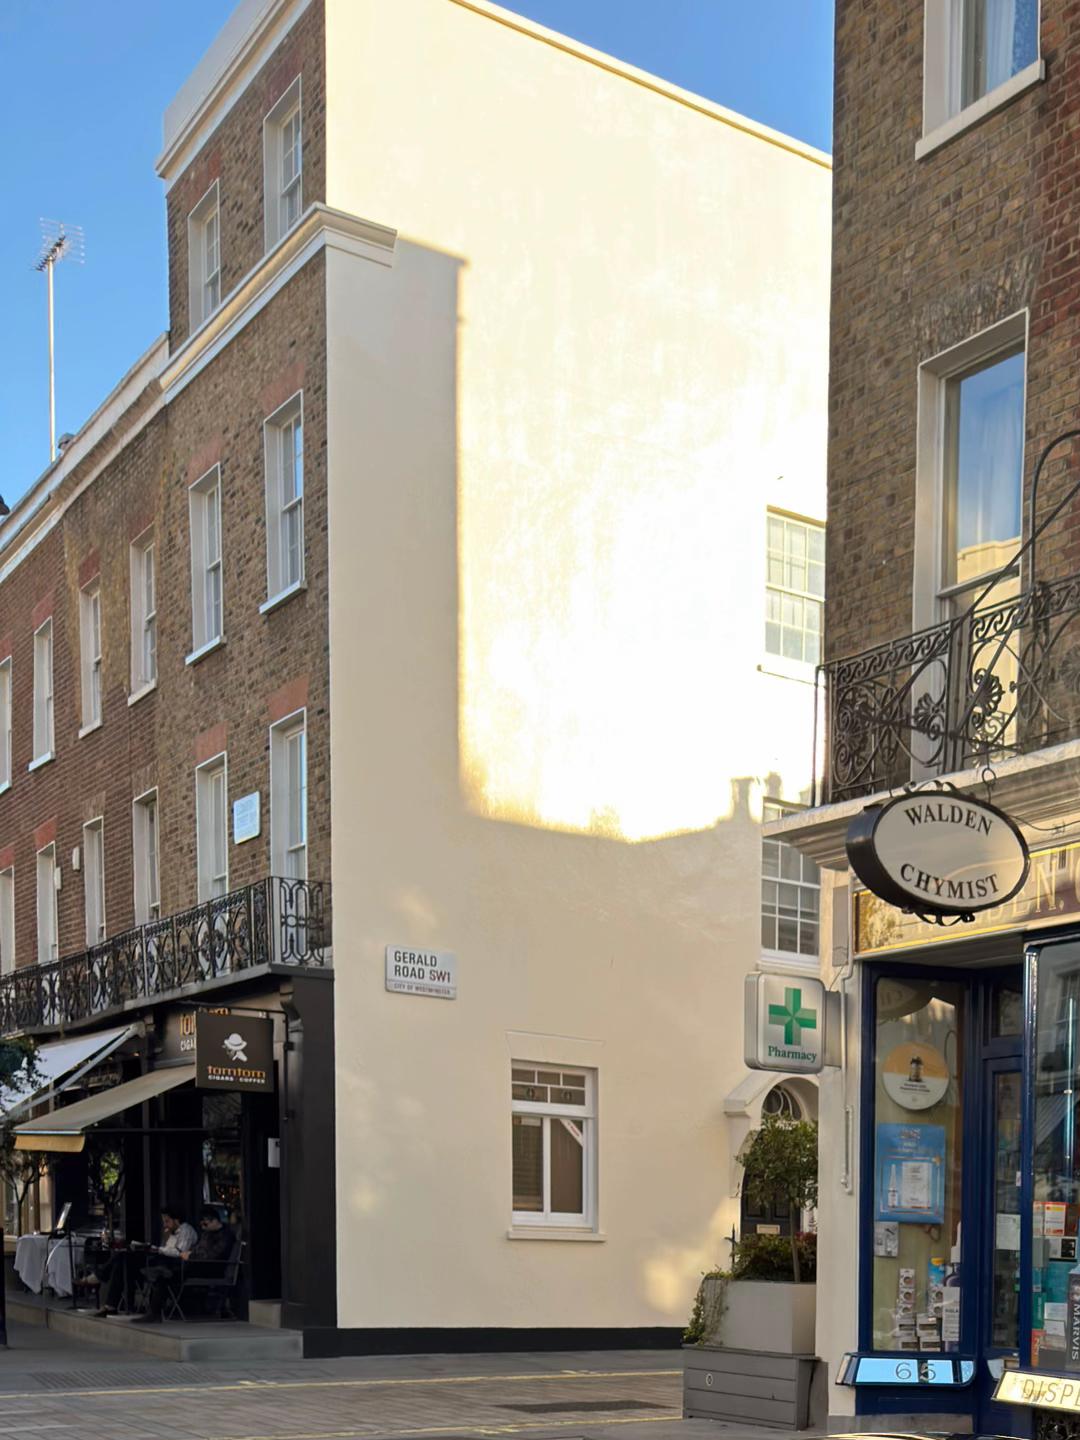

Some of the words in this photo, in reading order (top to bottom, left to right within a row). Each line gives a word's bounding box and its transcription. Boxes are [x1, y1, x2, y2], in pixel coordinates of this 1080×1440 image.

[904, 803, 994, 837] WALDEN
[900, 863, 1000, 900] CHYMIST
[394, 950, 438, 967] GERALD
[394, 965, 425, 979] ROAD
[429, 969, 451, 983] SW1
[768, 1045, 818, 1062] Pharmacy
[208, 1074, 234, 1082] CIGARS
[895, 1362, 937, 1381] 65
